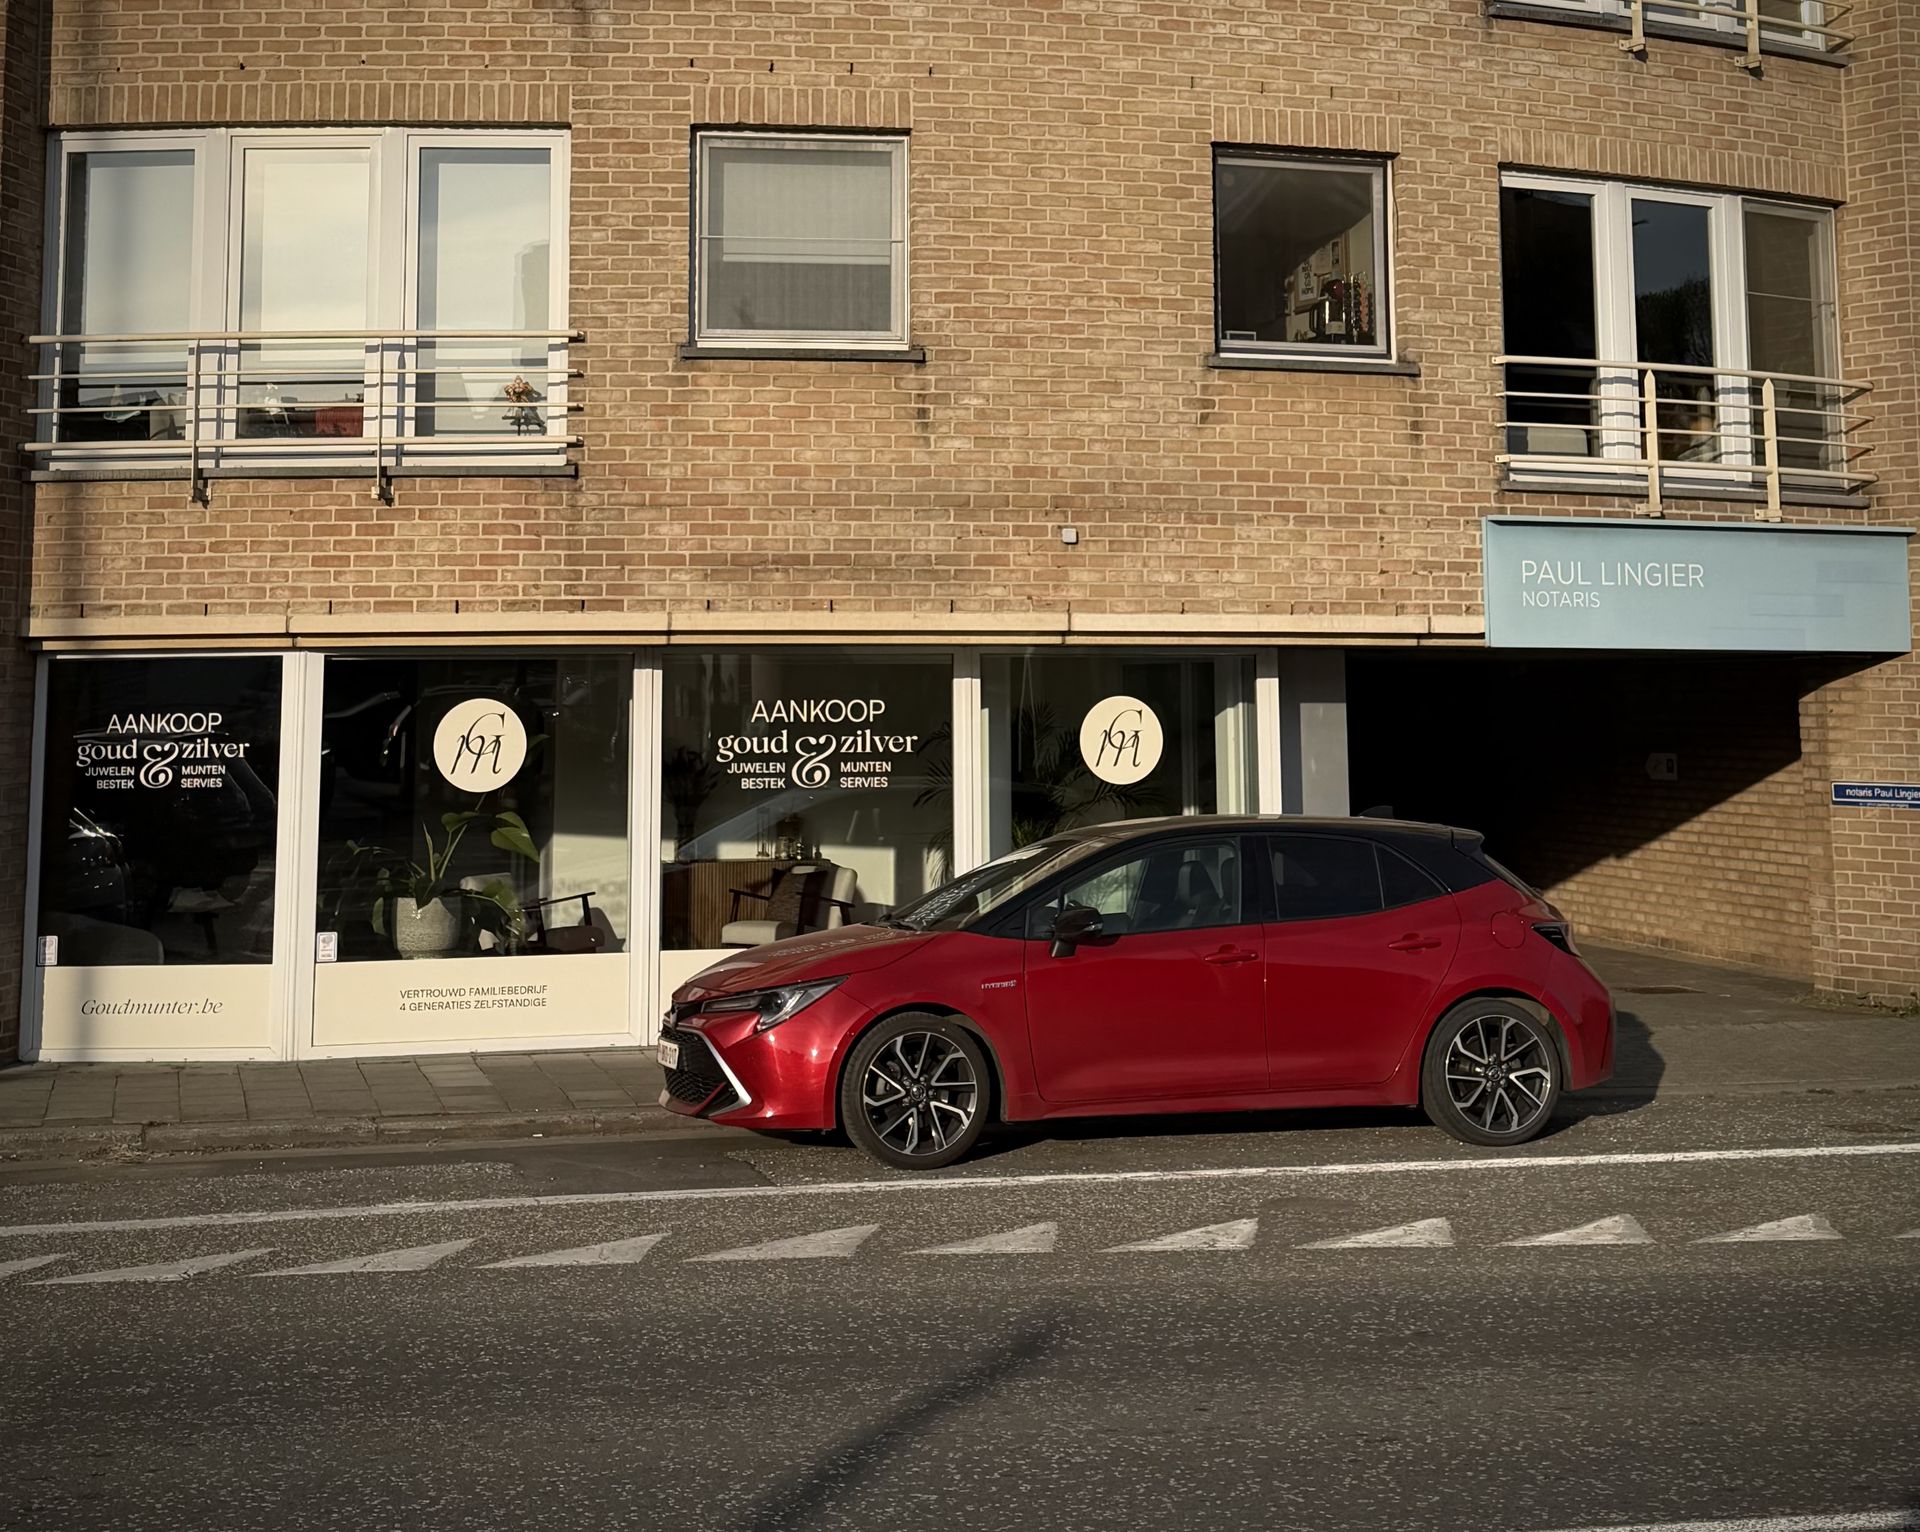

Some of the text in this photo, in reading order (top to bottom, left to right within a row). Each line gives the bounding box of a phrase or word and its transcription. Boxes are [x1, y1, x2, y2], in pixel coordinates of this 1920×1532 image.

[1521, 560, 1705, 587] PAUL LINGIER
[1522, 591, 1601, 608] NOTARIS
[751, 699, 886, 723] AANKOOP
[106, 712, 223, 734] AANKOOP
[76, 737, 250, 789] goud & zilver
[716, 728, 919, 789] goud & zilver
[85, 766, 135, 777] JUWELEN
[181, 765, 226, 776] MUNTEN
[727, 762, 786, 774] JUWELEN
[840, 761, 892, 773] MUNTEN
[96, 779, 135, 790] BESTEK
[180, 777, 223, 789] SERVIES
[741, 777, 786, 790] BESTEK
[839, 776, 889, 788] SERVIES
[1846, 788, 1872, 797] notaris
[1874, 788, 1893, 797] Paul
[400, 985, 548, 998] VERTROUWD FAMILIEBEDRIJF
[80, 998, 224, 1016] Goudmunter.be
[399, 998, 547, 1011] 4 GENERATIES ZELFSTANDIGE
